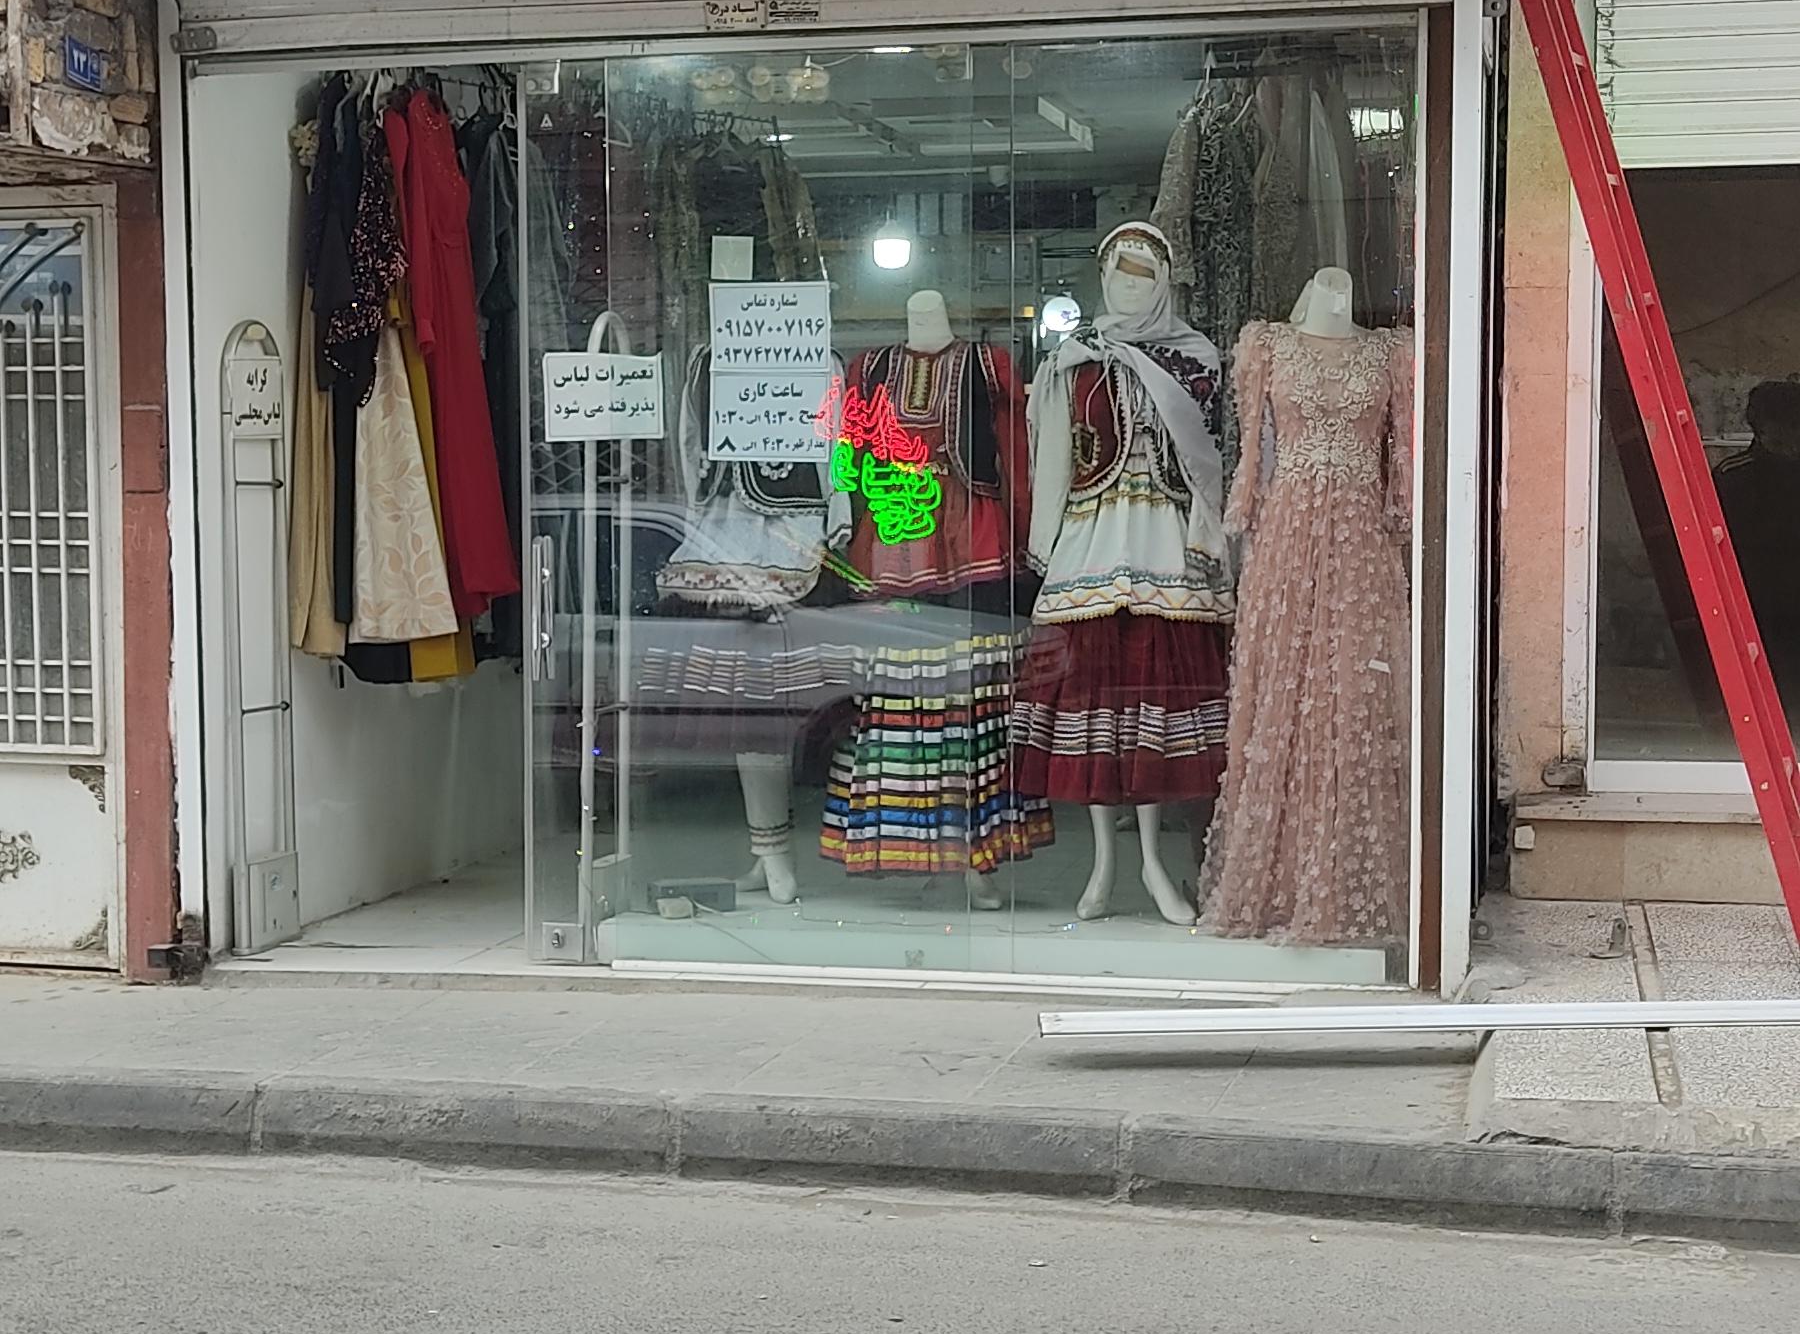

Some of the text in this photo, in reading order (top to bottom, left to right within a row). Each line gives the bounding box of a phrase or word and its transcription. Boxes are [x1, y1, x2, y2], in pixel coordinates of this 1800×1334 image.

[741, 293, 798, 312] شماره تماس
[716, 317, 825, 338] ۰۹۱۵۷۰۰۷۱۹۶
[716, 346, 824, 364] ۰۹۳۷۴۲۷۲۸۸۷
[246, 367, 268, 393] کرایه
[553, 363, 654, 388] تعمیرات لباس
[738, 382, 803, 403] ساعت کاری
[234, 402, 280, 427] لباس مجلسی
[553, 397, 657, 420] پذیرفته می شود
[746, 414, 761, 425] الی
[716, 435, 737, 452] ۸
[742, 441, 757, 452] الی
